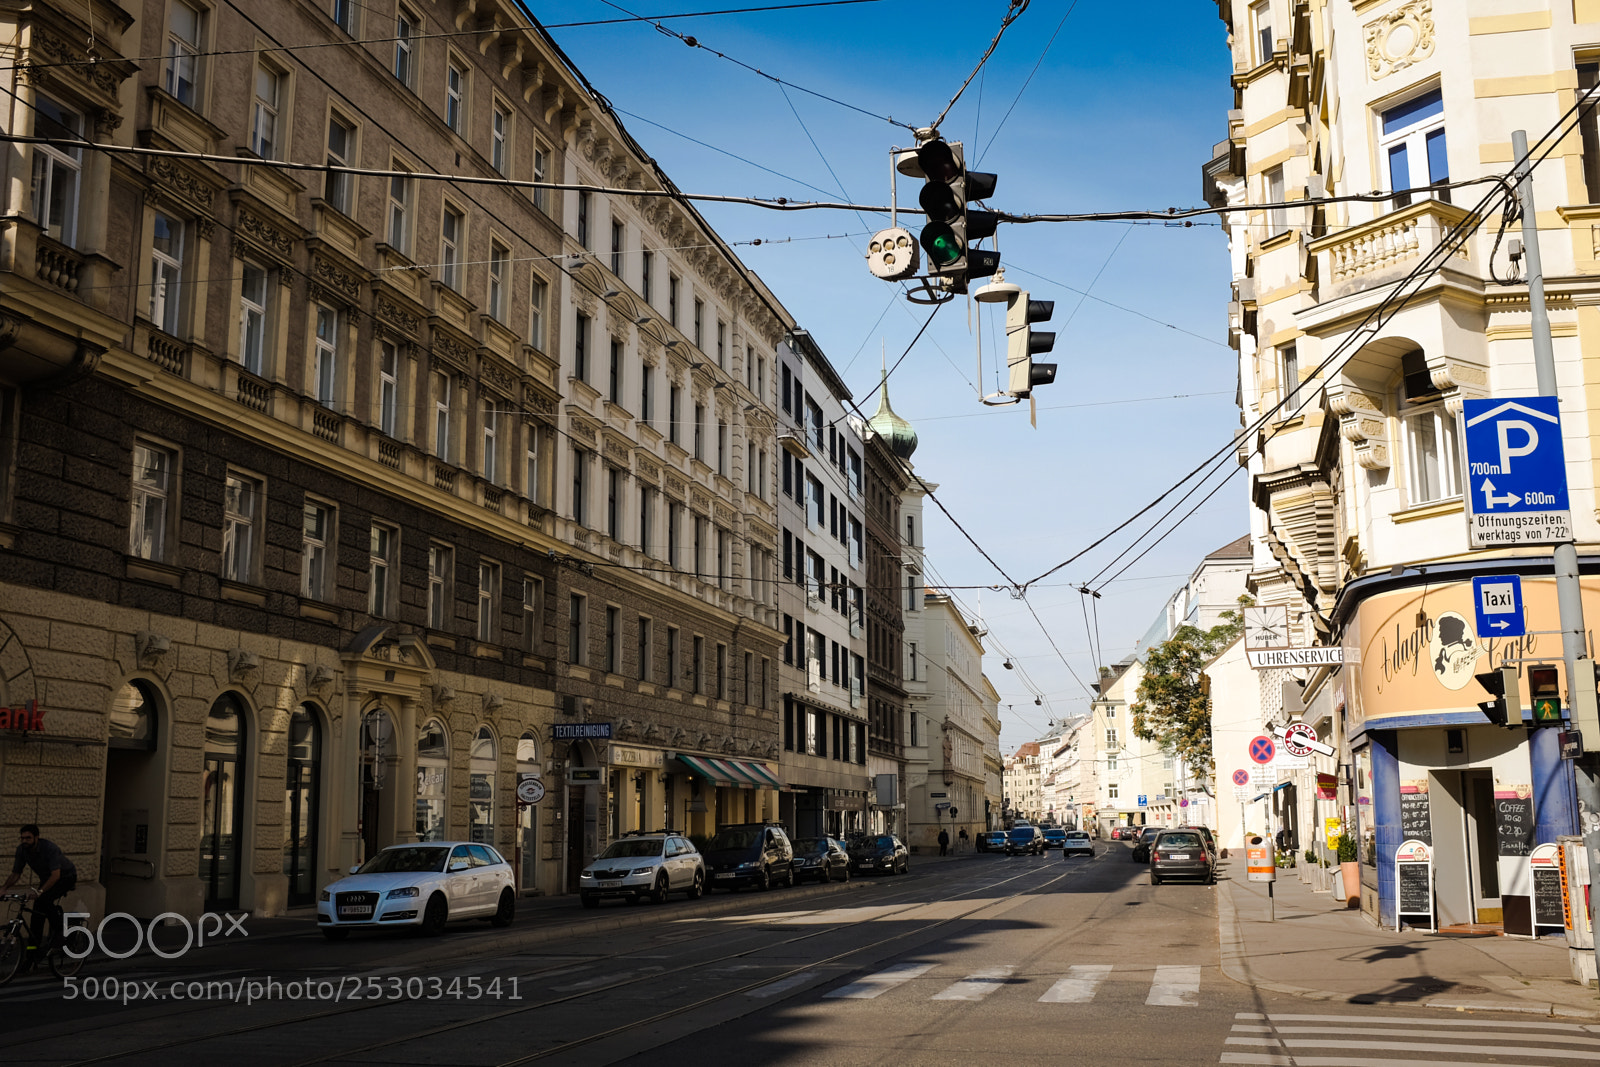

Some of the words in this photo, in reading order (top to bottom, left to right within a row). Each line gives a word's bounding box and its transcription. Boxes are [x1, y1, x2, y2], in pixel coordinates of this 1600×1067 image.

[1496, 419, 1539, 475] P
[1470, 462, 1500, 476] 700m
[1524, 491, 1556, 506] 600m
[1478, 513, 1566, 529] Öffnungszeiten:
[1477, 529, 1521, 543] werktags
[1525, 530, 1542, 541] von
[1483, 590, 1512, 607] Taxi
[1257, 649, 1343, 666] UHRENSERVICE
[555, 724, 610, 738] TEXTILREINIGUNG
[1290, 725, 1315, 737] TABAK
[1285, 737, 1309, 754] TRAFIK
[1499, 801, 1526, 813] COFFEE
